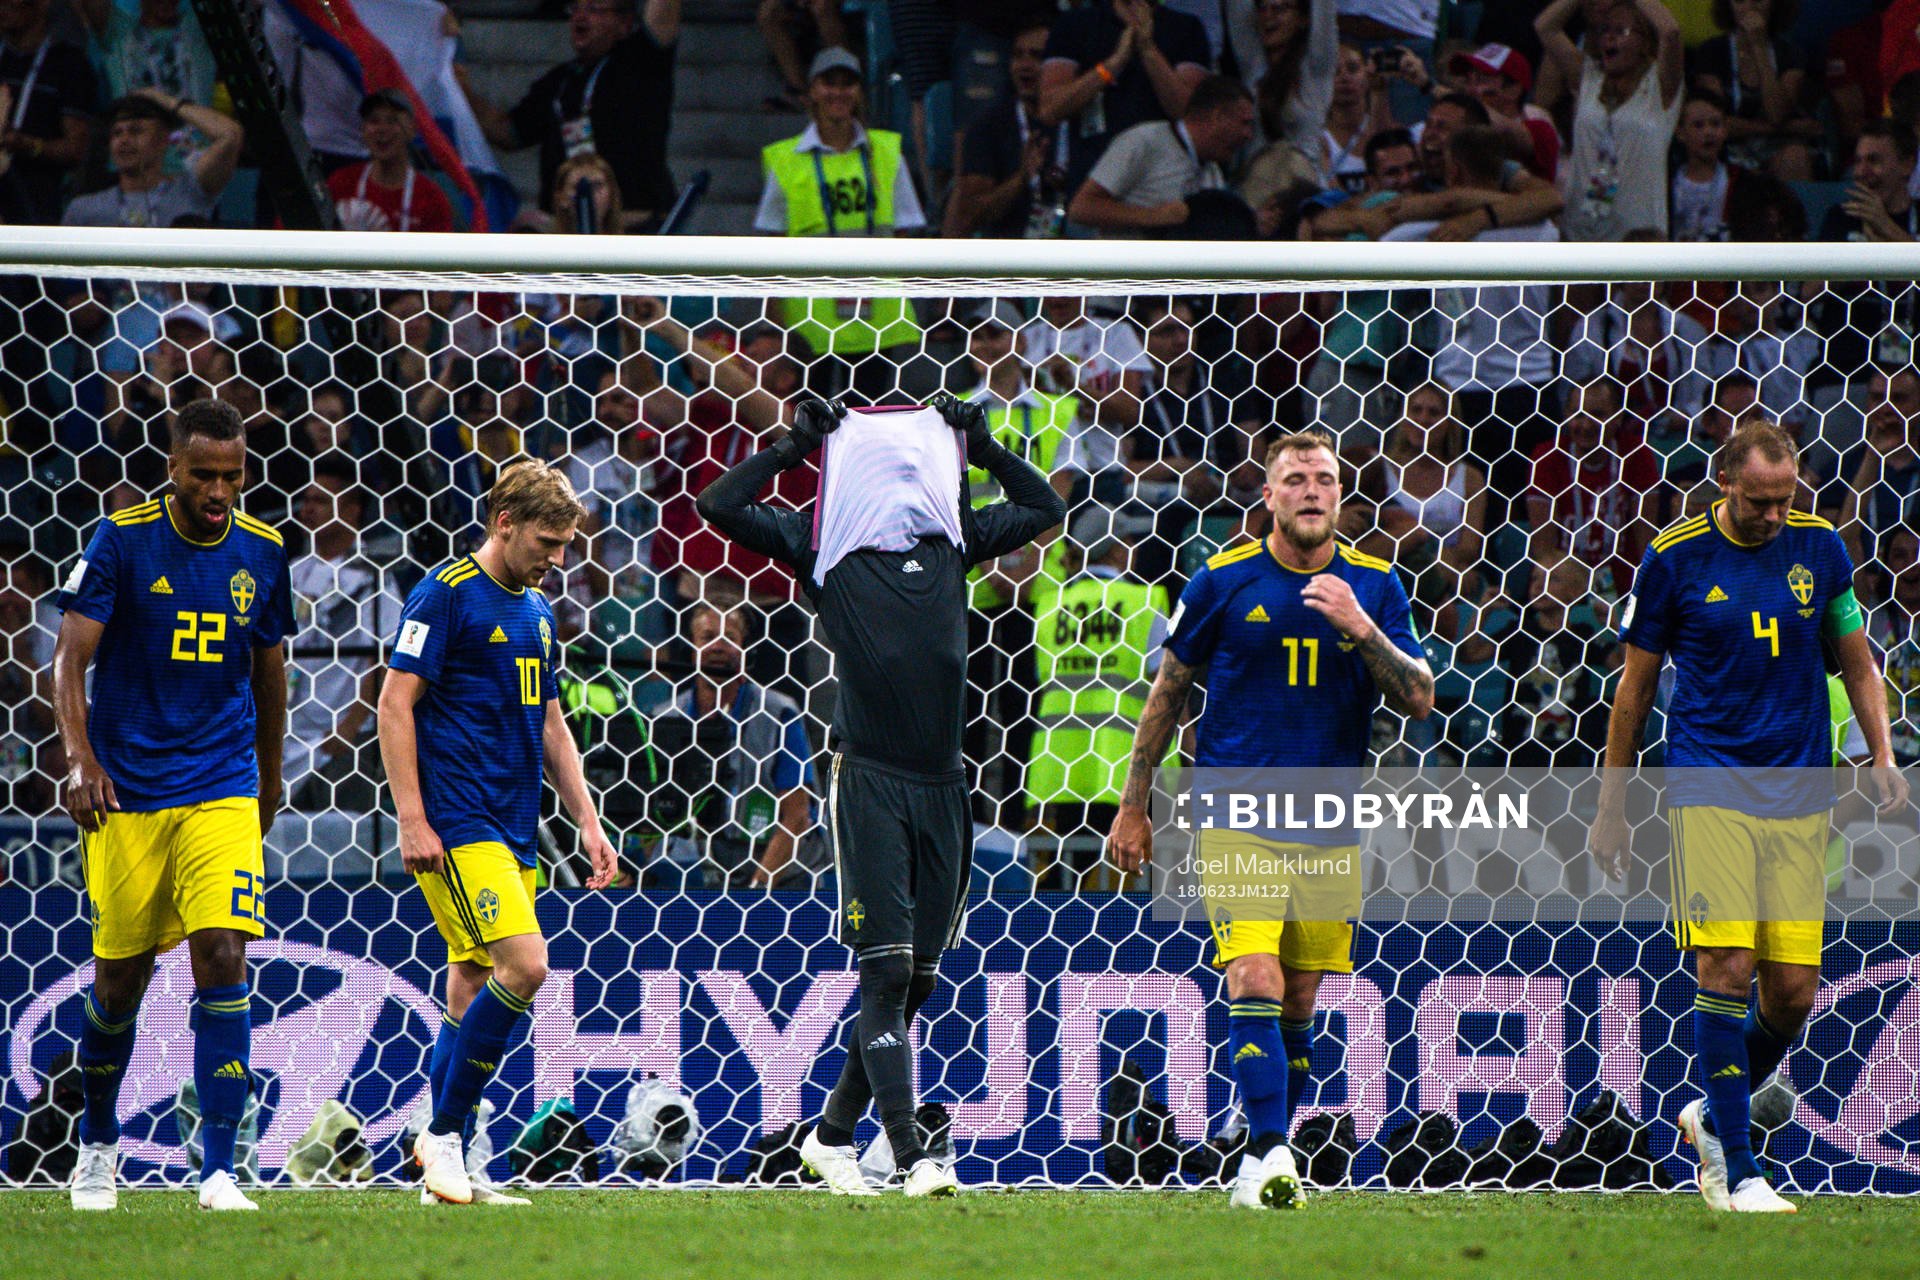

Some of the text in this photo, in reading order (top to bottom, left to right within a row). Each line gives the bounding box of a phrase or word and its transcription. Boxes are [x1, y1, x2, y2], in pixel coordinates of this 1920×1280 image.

[171, 610, 226, 663] 22
[1752, 611, 1780, 657] 4
[515, 657, 541, 706] 10
[1282, 637, 1319, 687] 11
[231, 869, 265, 925] 22
